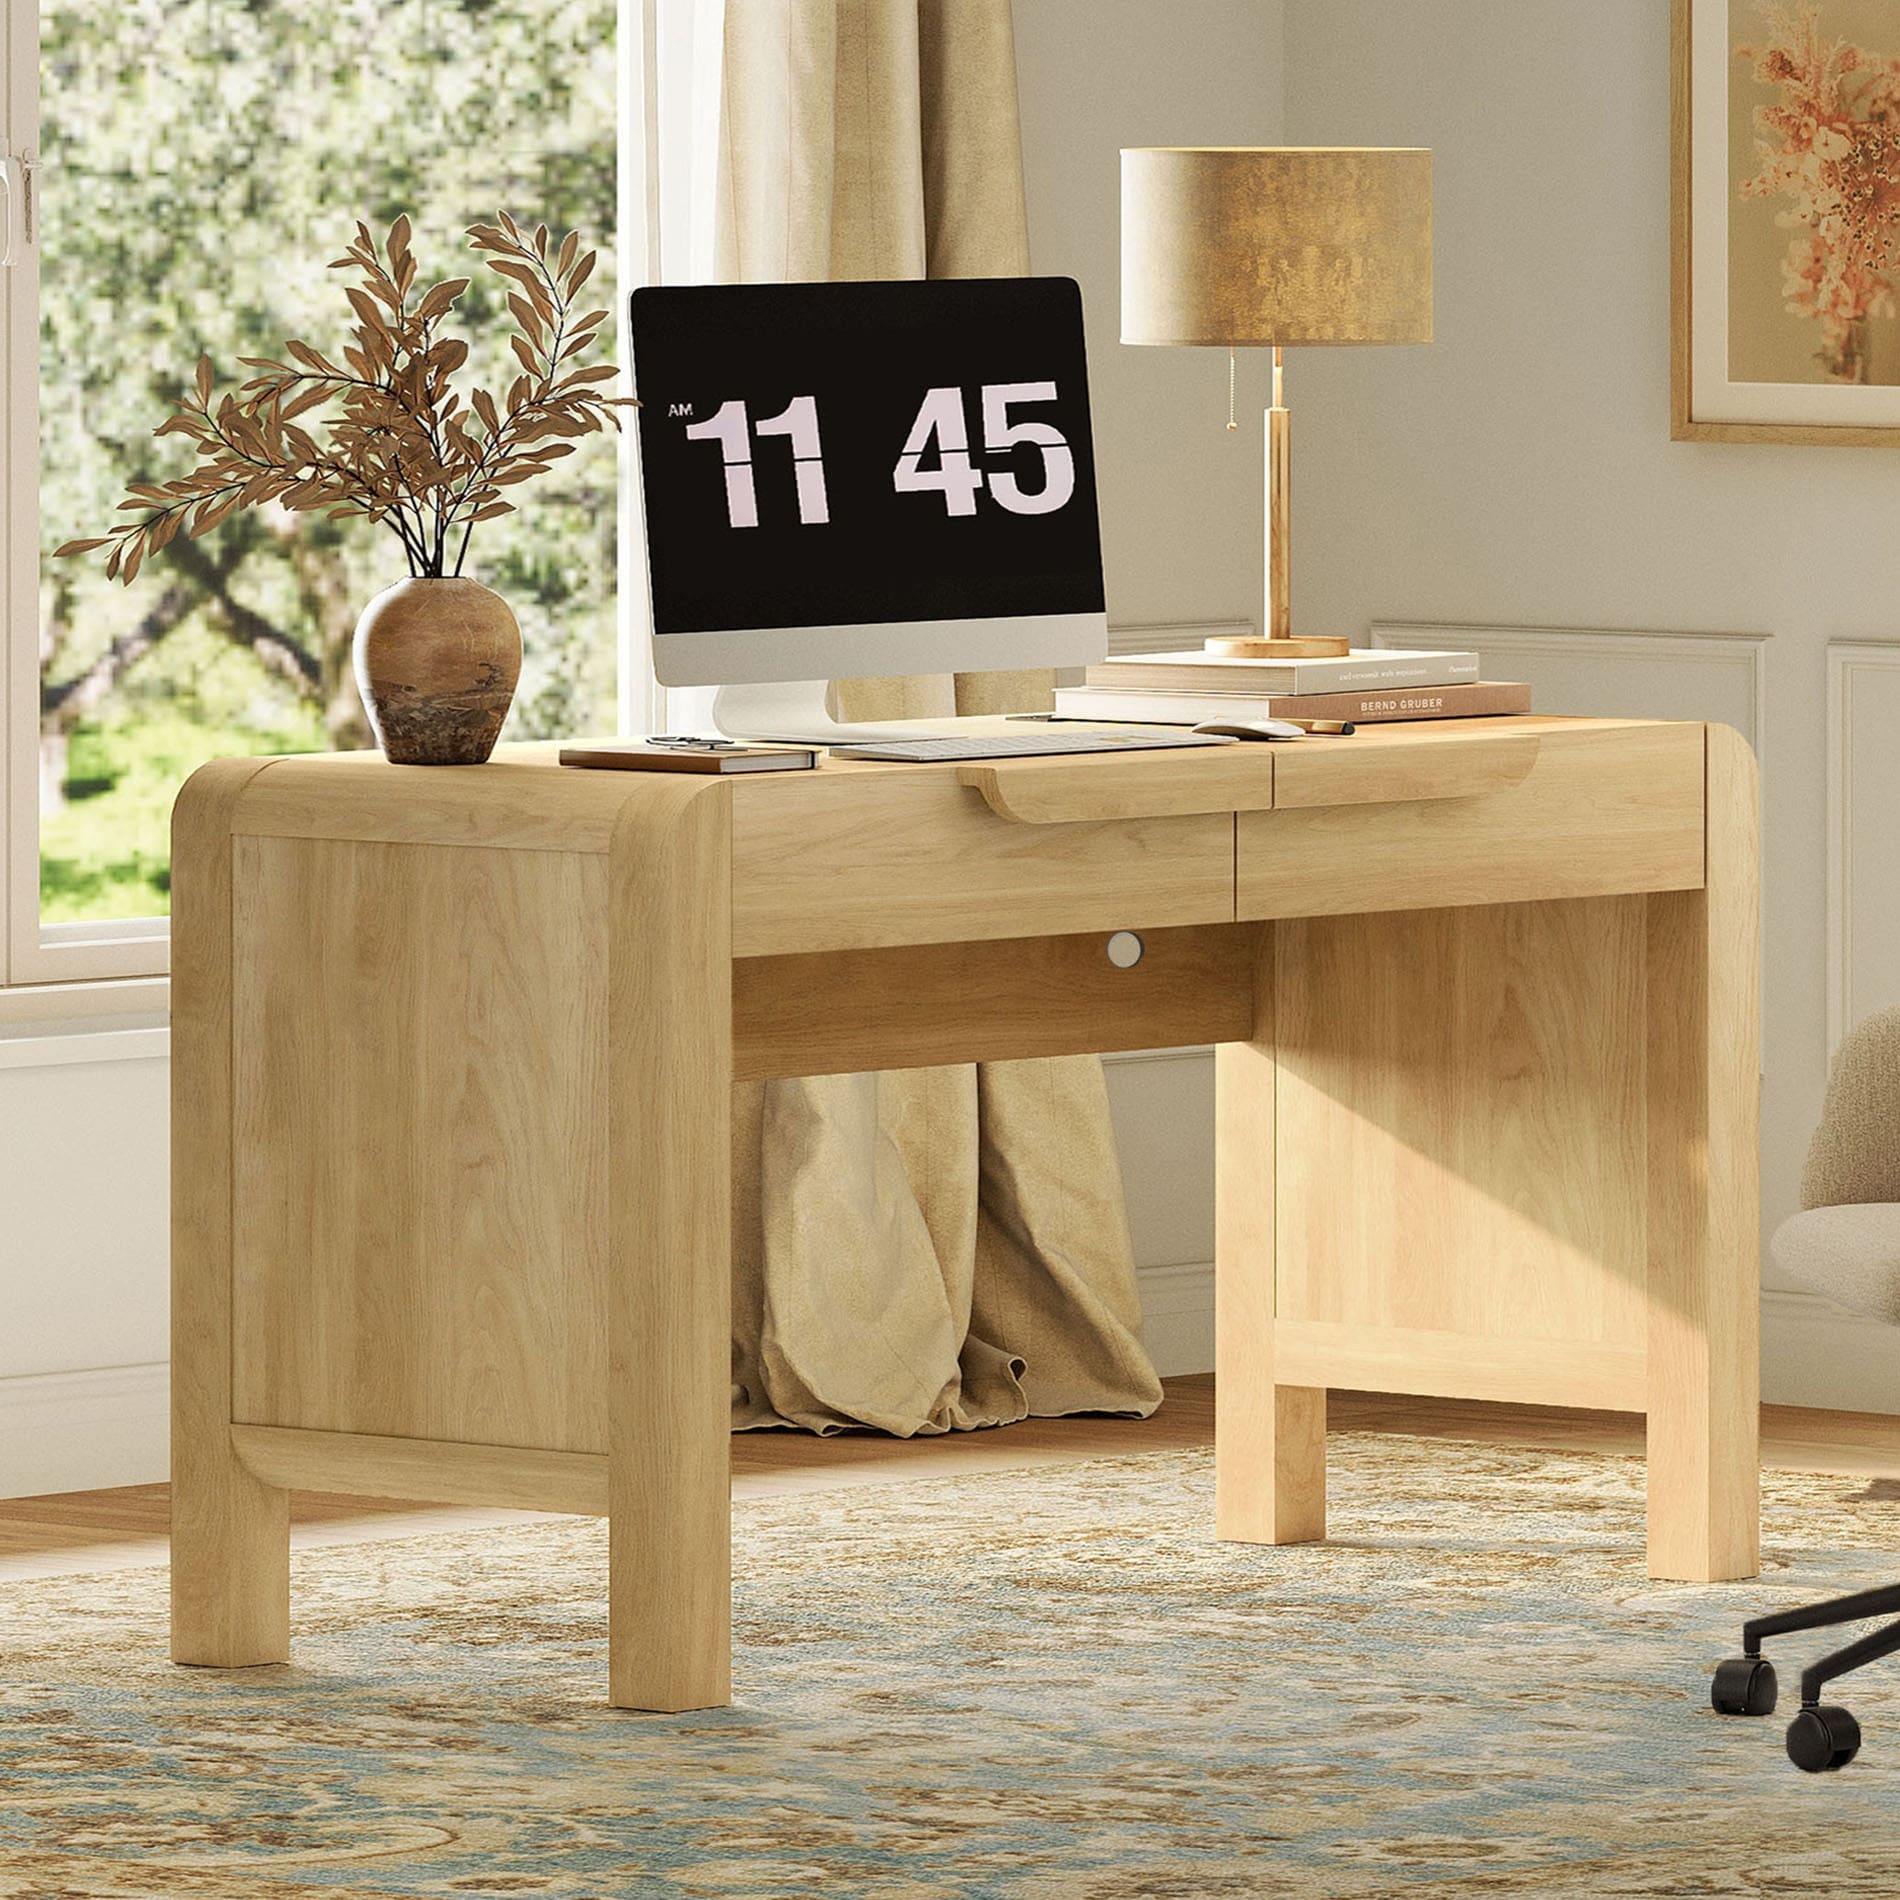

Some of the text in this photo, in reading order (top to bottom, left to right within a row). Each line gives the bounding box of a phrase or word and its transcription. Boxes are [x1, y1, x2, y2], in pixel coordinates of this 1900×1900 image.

[669, 404, 693, 416] AM
[686, 381, 1074, 527] 11 45
[1360, 698, 1443, 711] BERND GRUBER
